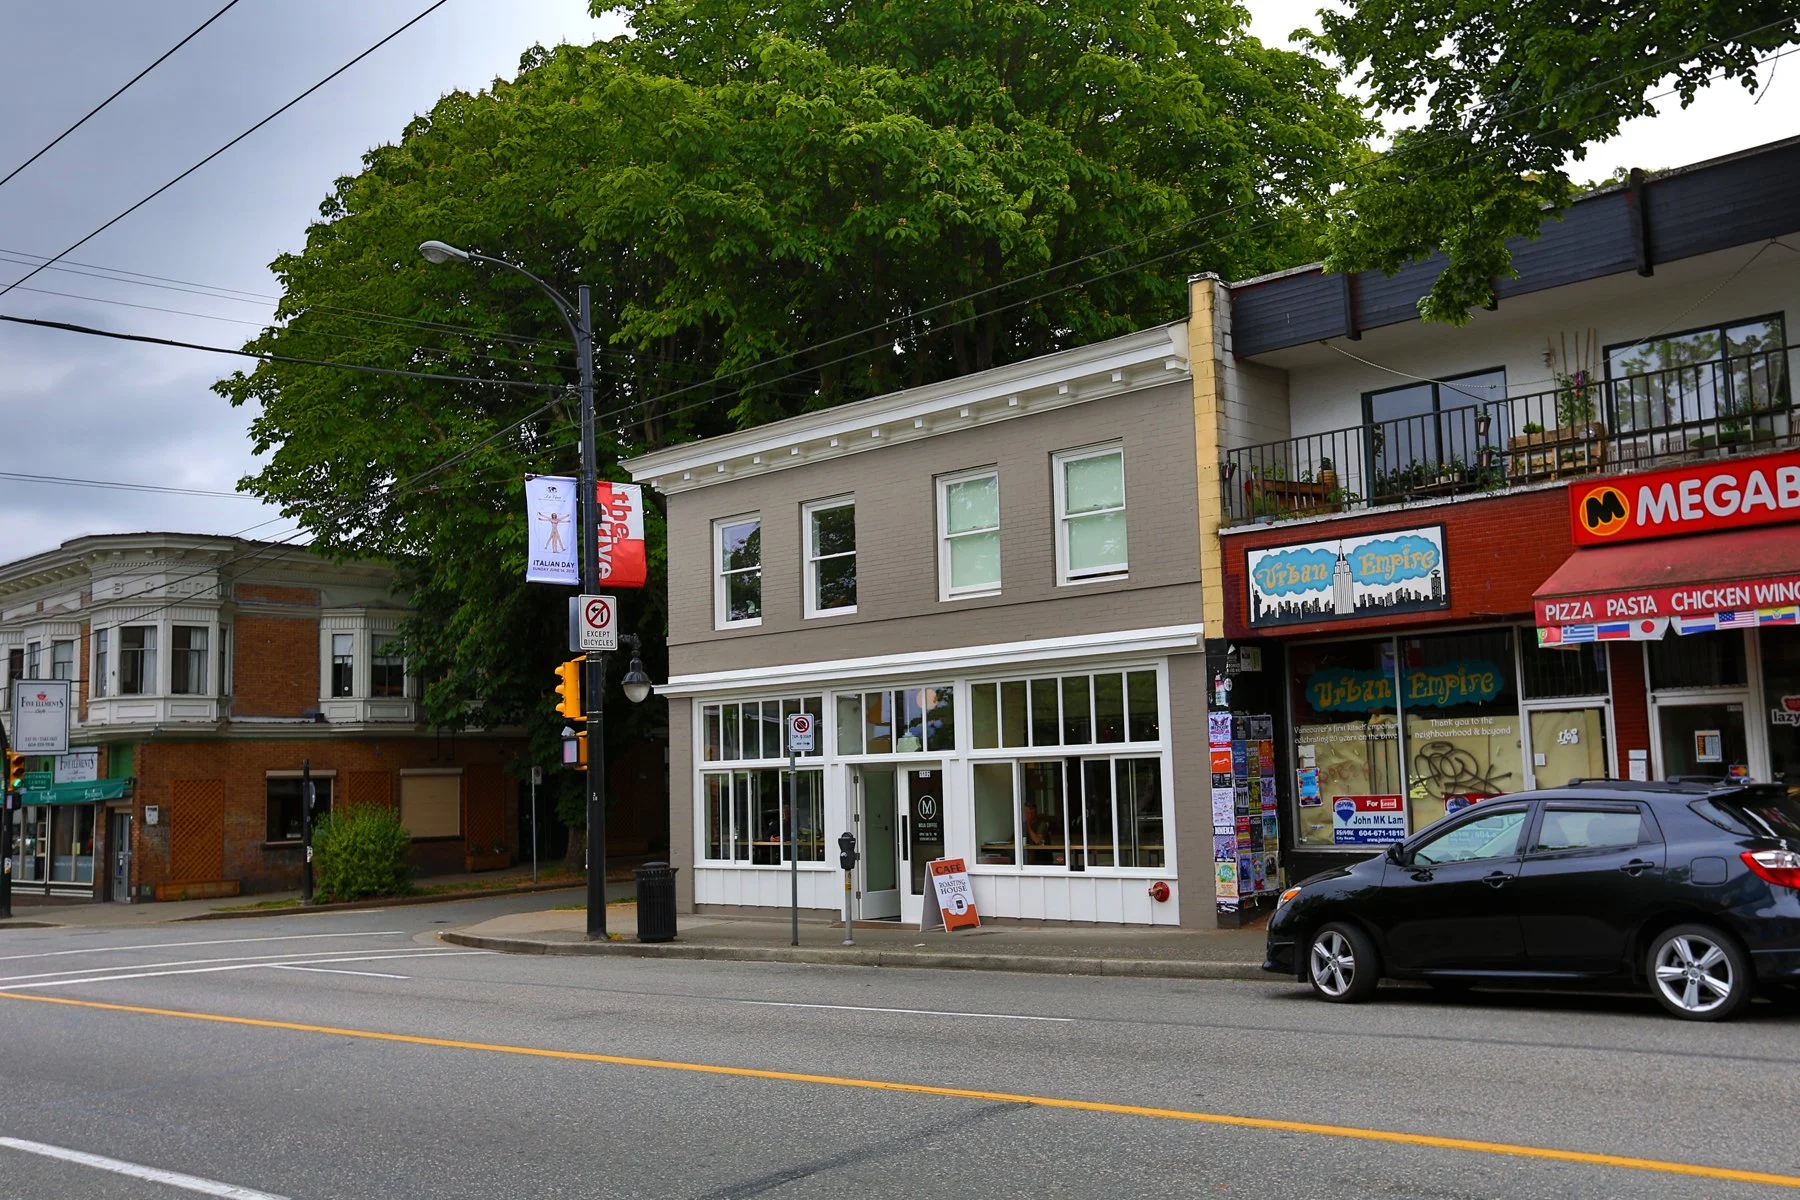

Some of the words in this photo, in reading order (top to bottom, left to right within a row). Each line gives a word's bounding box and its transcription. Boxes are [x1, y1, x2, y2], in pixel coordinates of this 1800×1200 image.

[612, 491, 632, 539] the
[533, 559, 560, 568] ITALIAN
[1256, 561, 1329, 589] Urban
[1358, 543, 1436, 580] Empire
[1545, 601, 1594, 622] PIZZA
[1606, 595, 1658, 617] PASTA
[1671, 585, 1750, 612] CHICKEN
[586, 630, 610, 638] EXCEPT
[583, 639, 614, 647] BICYCLES
[1313, 675, 1393, 708] Urban
[1407, 664, 1495, 705] Empire
[1430, 718, 1454, 728] Thank
[1455, 718, 1470, 729] you
[1471, 717, 1480, 726] to
[1480, 716, 1494, 725] the
[1368, 732, 1379, 740] the
[1414, 727, 1472, 740] neighbourhood
[1473, 727, 1480, 736] &
[1481, 726, 1511, 739] beyond
[1353, 815, 1372, 825] John
[1373, 815, 1386, 824] MK
[1387, 815, 1404, 824] Lam
[1359, 829, 1404, 837] 604-671-1818
[935, 863, 963, 875] CAFE
[938, 878, 967, 889] ROASTING
[940, 886, 968, 895] HOUSE
